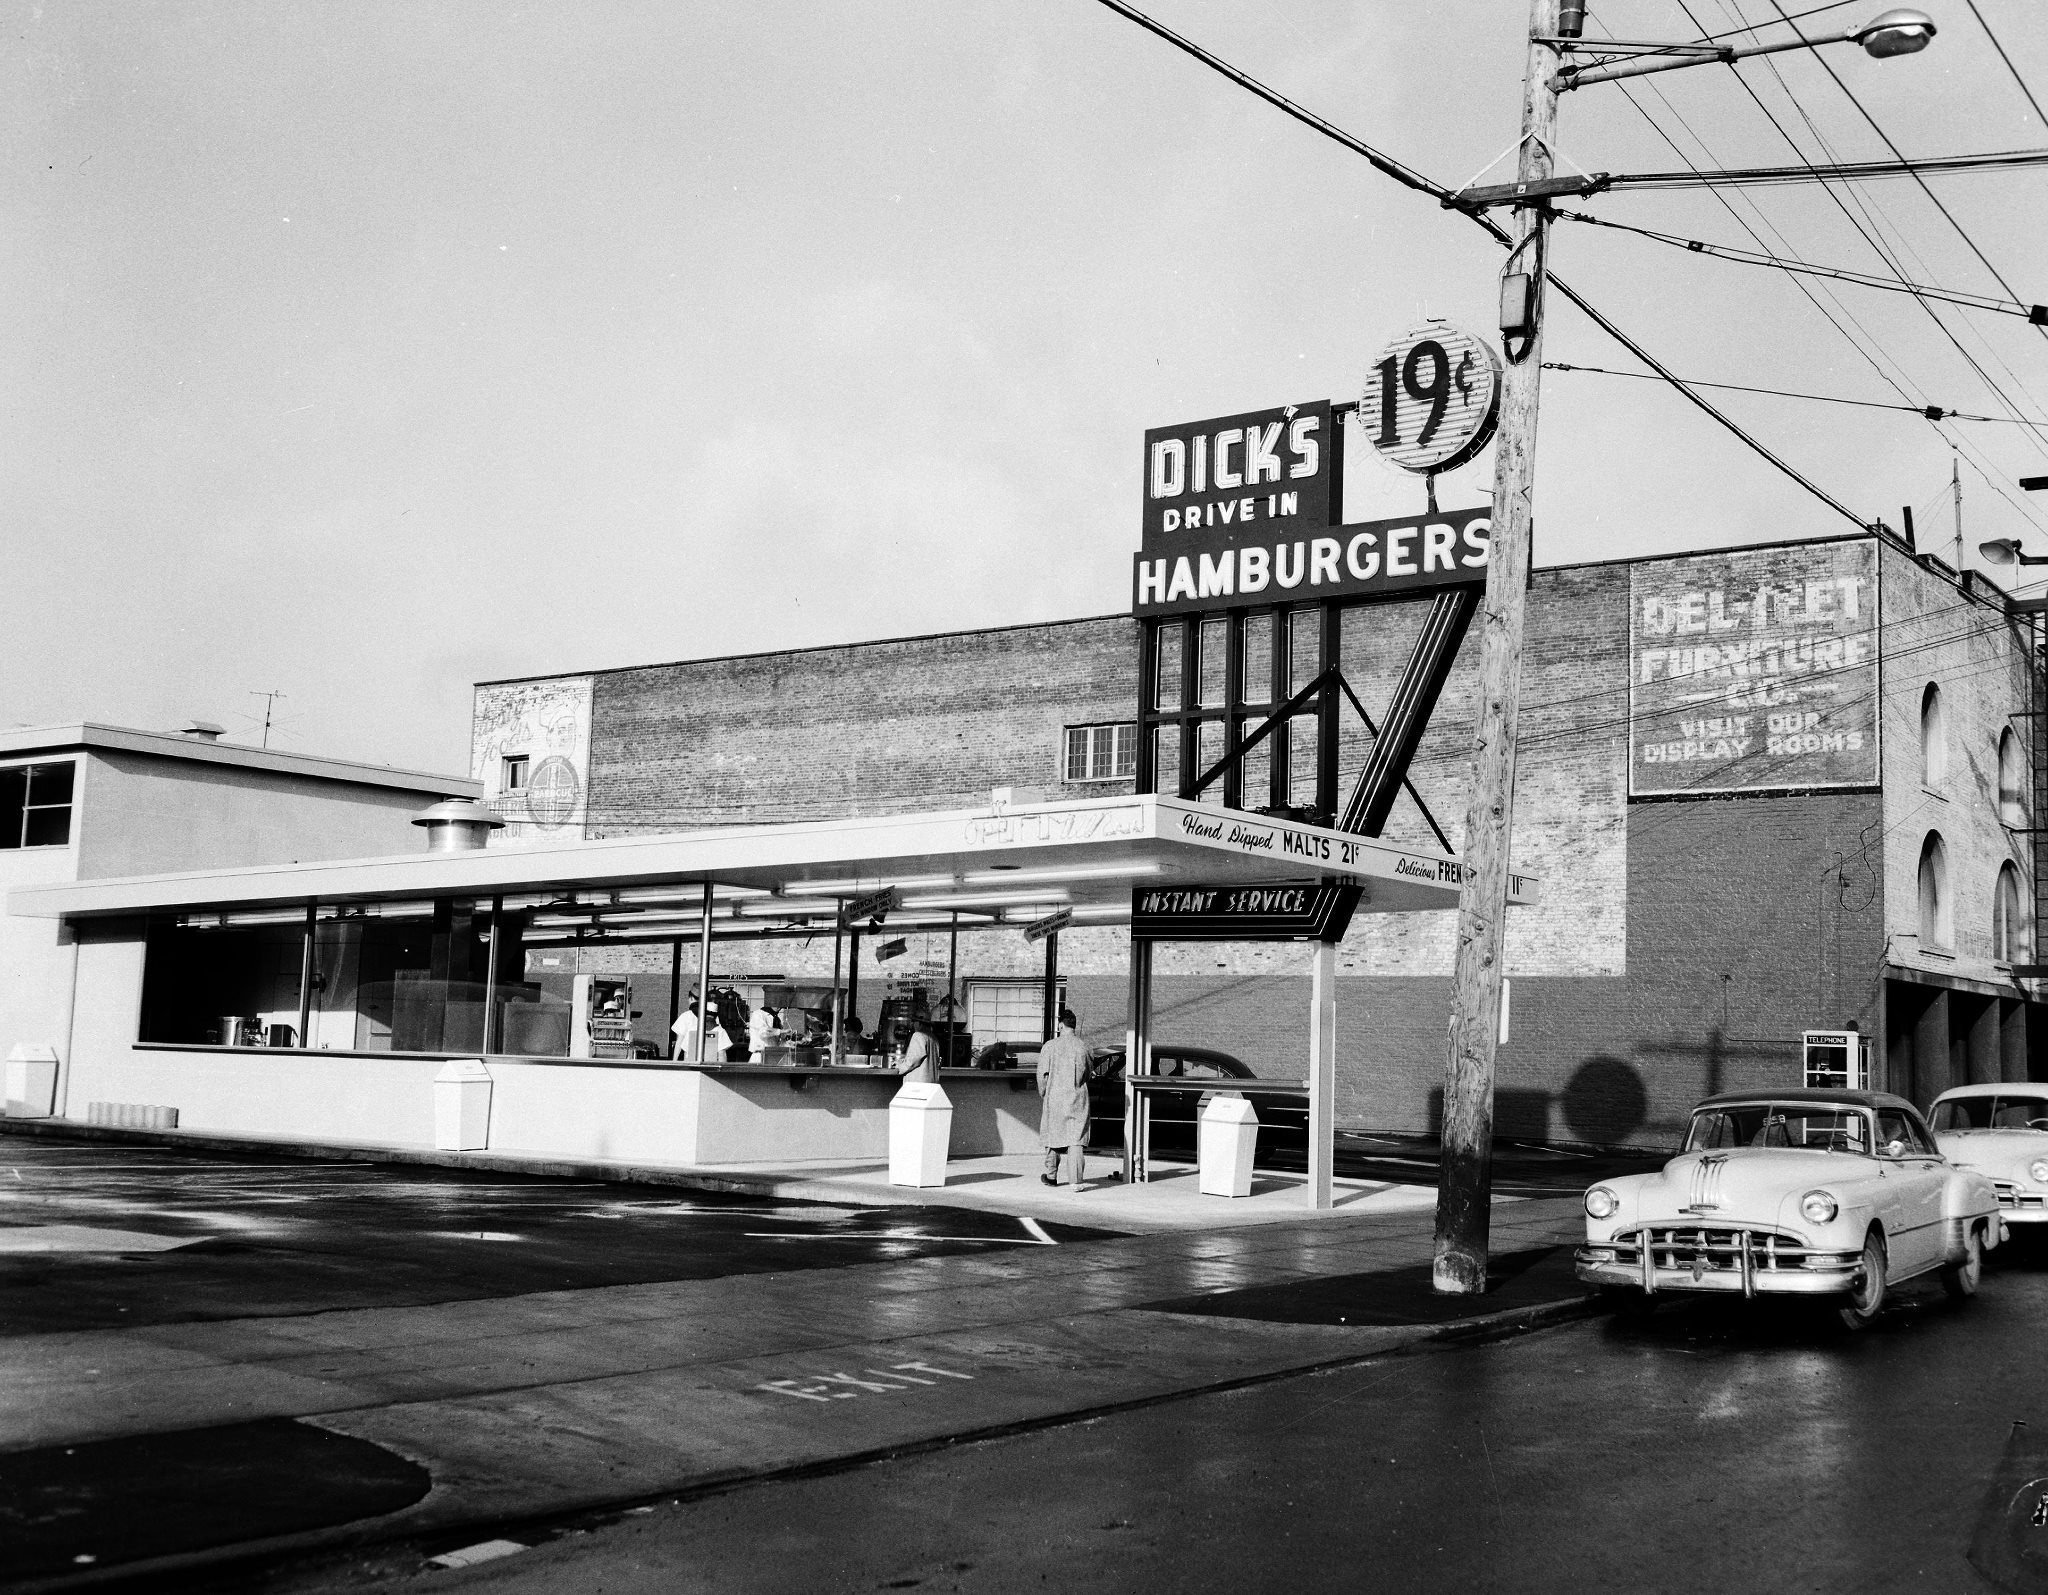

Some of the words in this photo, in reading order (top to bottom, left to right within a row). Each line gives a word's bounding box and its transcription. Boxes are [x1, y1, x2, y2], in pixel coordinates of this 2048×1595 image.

[1374, 339, 1477, 449] 19¢
[1151, 405, 1320, 499] DICK'S
[1163, 497, 1257, 532] DRIVE
[1268, 491, 1298, 518] IN
[1138, 517, 1492, 605] HAMBURGERS
[1680, 715, 1750, 738] VISIT
[1766, 711, 1823, 735] OUR
[1643, 736, 1749, 763] DISPLAY
[1765, 730, 1864, 755] ROOMS
[1183, 813, 1223, 840] Hand
[1227, 825, 1274, 851] Dipped
[1283, 830, 1331, 860] MALTS
[1341, 842, 1360, 865] 21¢
[1395, 857, 1436, 881] Delicious
[1438, 861, 1463, 885] FREN
[1141, 891, 1218, 913] INSTANT
[1225, 889, 1306, 912] SERVICE
[1807, 1036, 1846, 1044] TELEPHONE
[755, 1361, 976, 1402] EXIT
